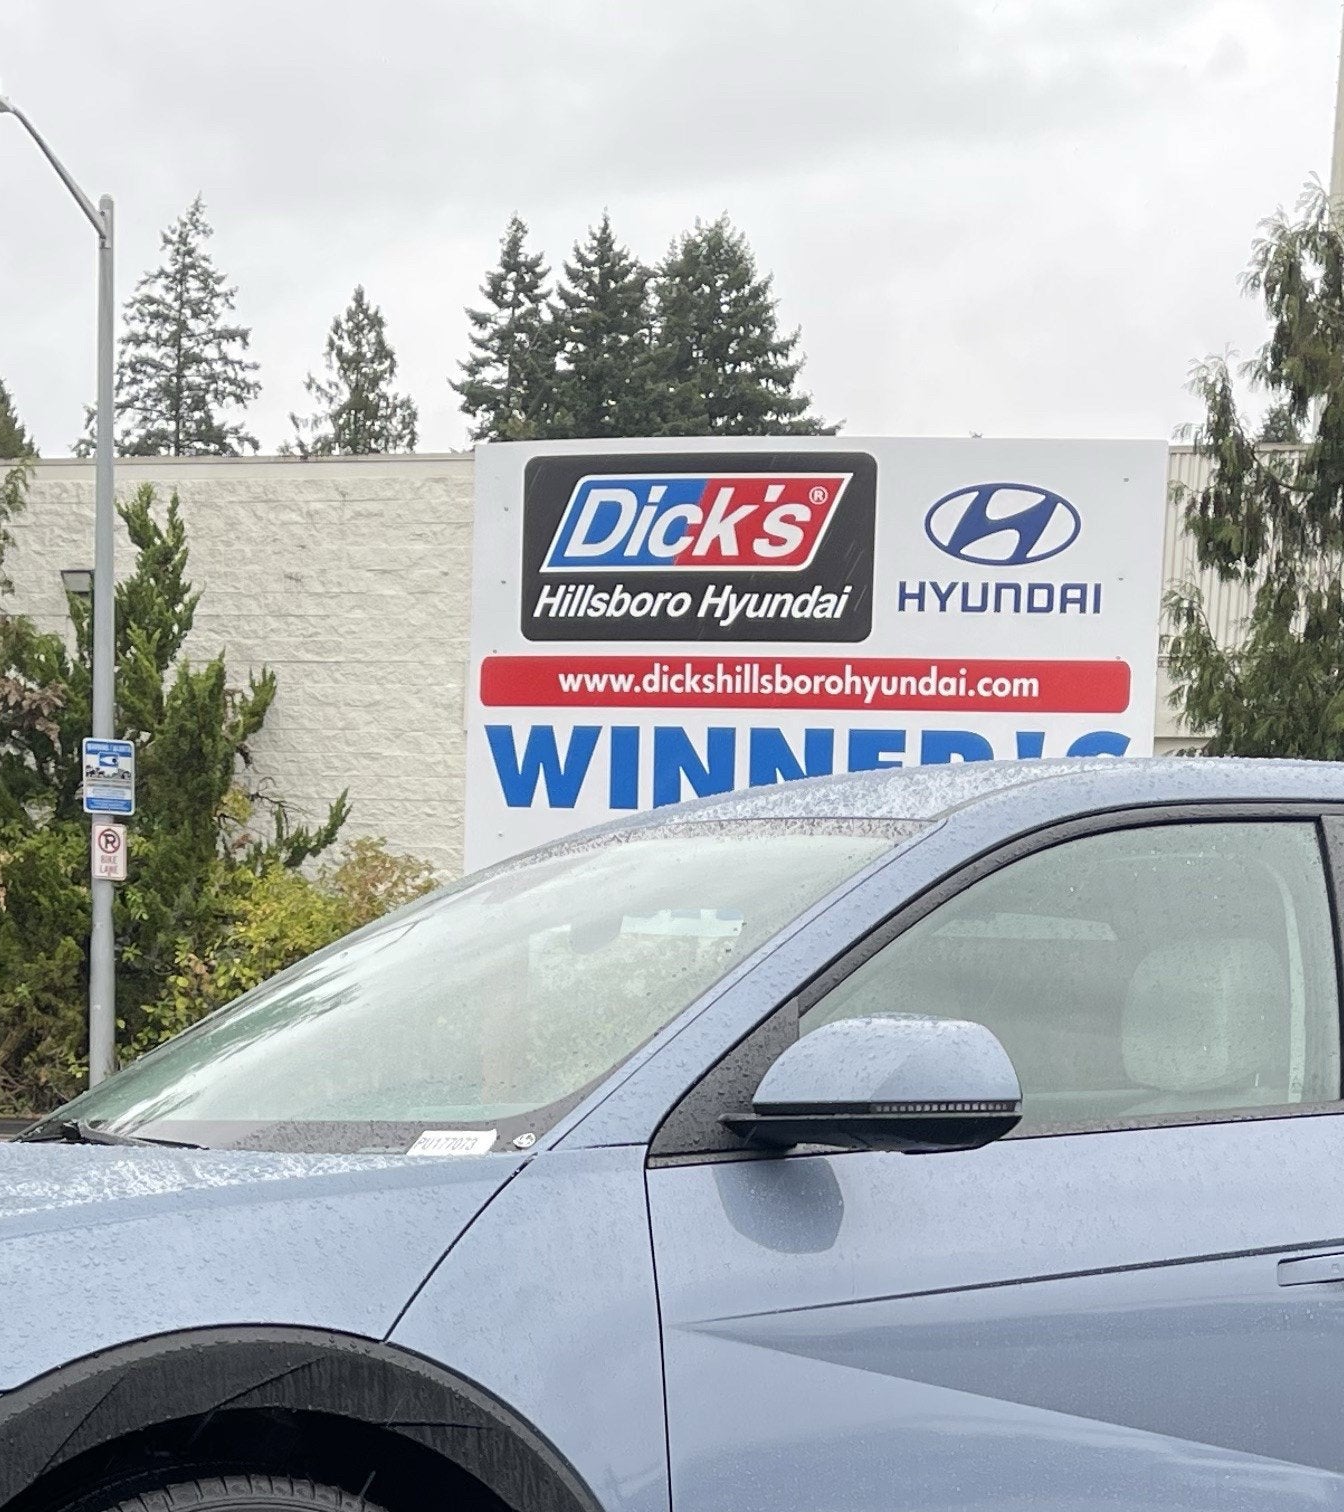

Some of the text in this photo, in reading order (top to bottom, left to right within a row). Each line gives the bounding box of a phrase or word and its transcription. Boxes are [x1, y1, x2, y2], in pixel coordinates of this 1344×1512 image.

[532, 584, 853, 627] Hillsboro Hyundai
[898, 581, 1102, 614] HYUNDAI
[558, 662, 1039, 704] www.dickshillsborohyundai.com
[485, 725, 1130, 810] WINNE'
